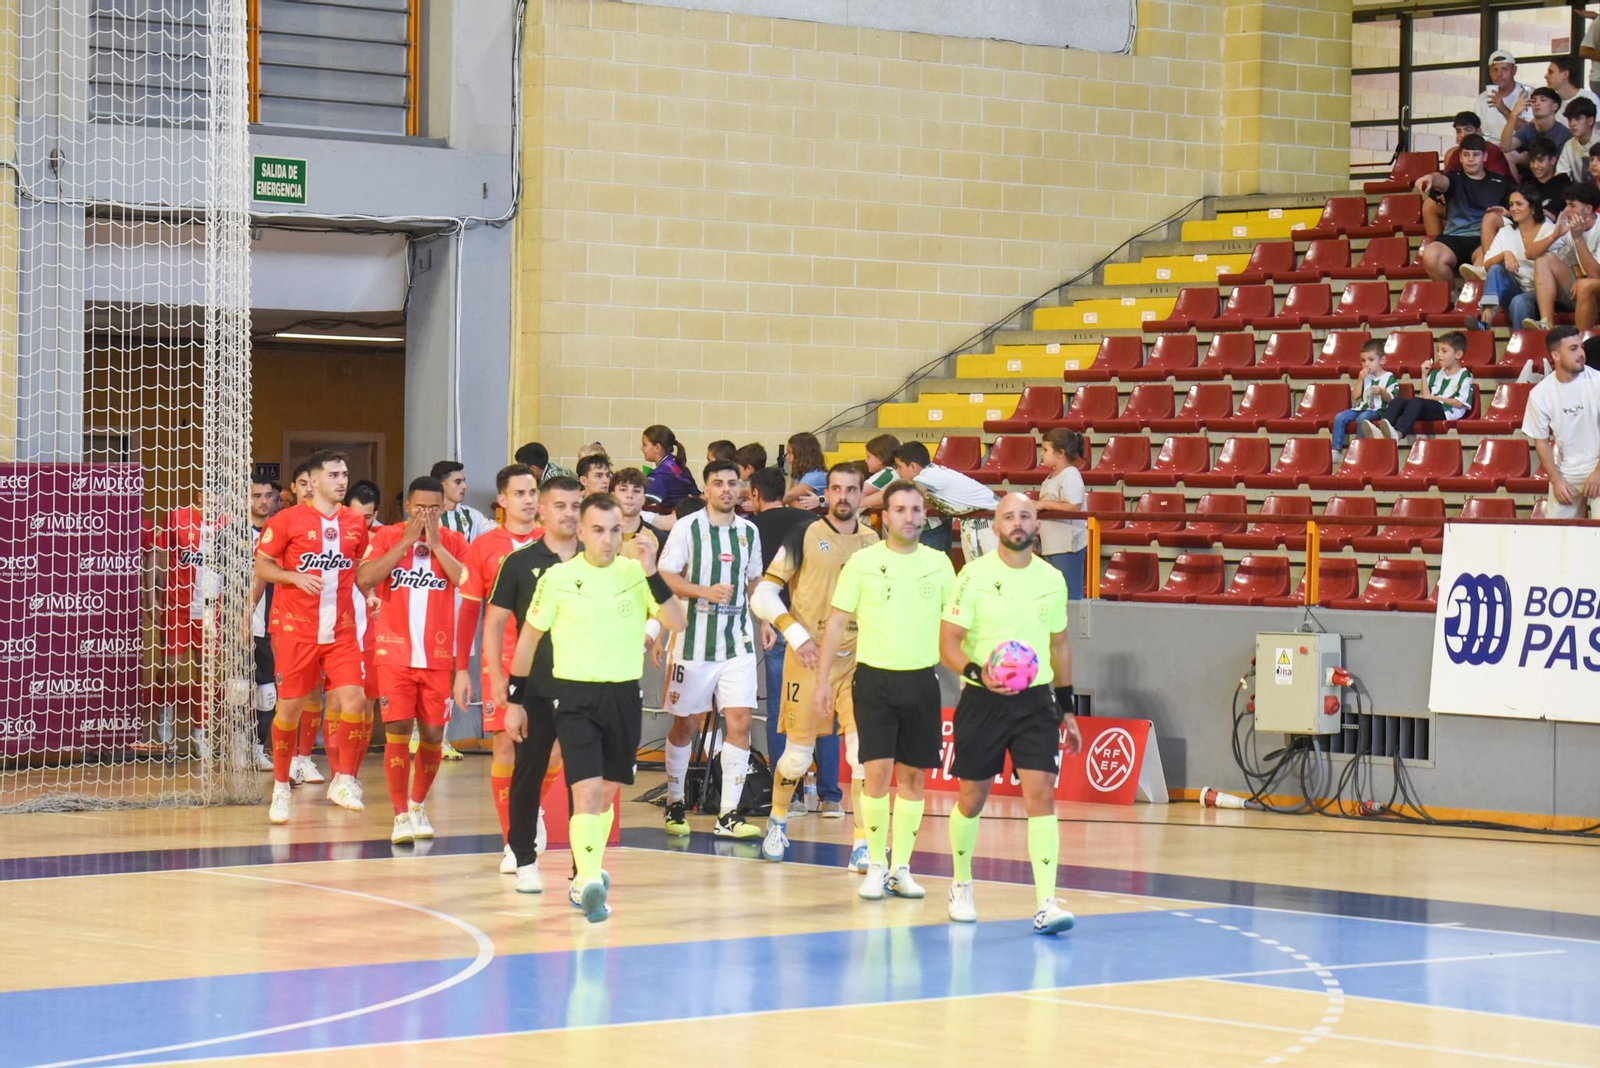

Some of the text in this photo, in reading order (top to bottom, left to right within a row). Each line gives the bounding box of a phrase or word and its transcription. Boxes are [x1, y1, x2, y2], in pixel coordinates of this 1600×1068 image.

[261, 163, 298, 180] SALIDA DE
[256, 181, 303, 198] EMERGENCIA
[90, 476, 144, 490] IMDECO
[47, 515, 104, 530] IMDECO
[97, 556, 143, 569] IMDEC
[298, 549, 352, 571] Jimbee
[390, 567, 447, 589] Jimbee
[46, 596, 104, 610] IMDECO
[1523, 586, 1600, 619] BOB
[97, 638, 144, 652] IMDEC
[672, 663, 684, 682] 16
[46, 678, 104, 692] IMDECO
[787, 682, 800, 702] 12
[97, 718, 144, 732] IMDEC
[1102, 748, 1121, 758] RF
[1100, 761, 1119, 771] EF
